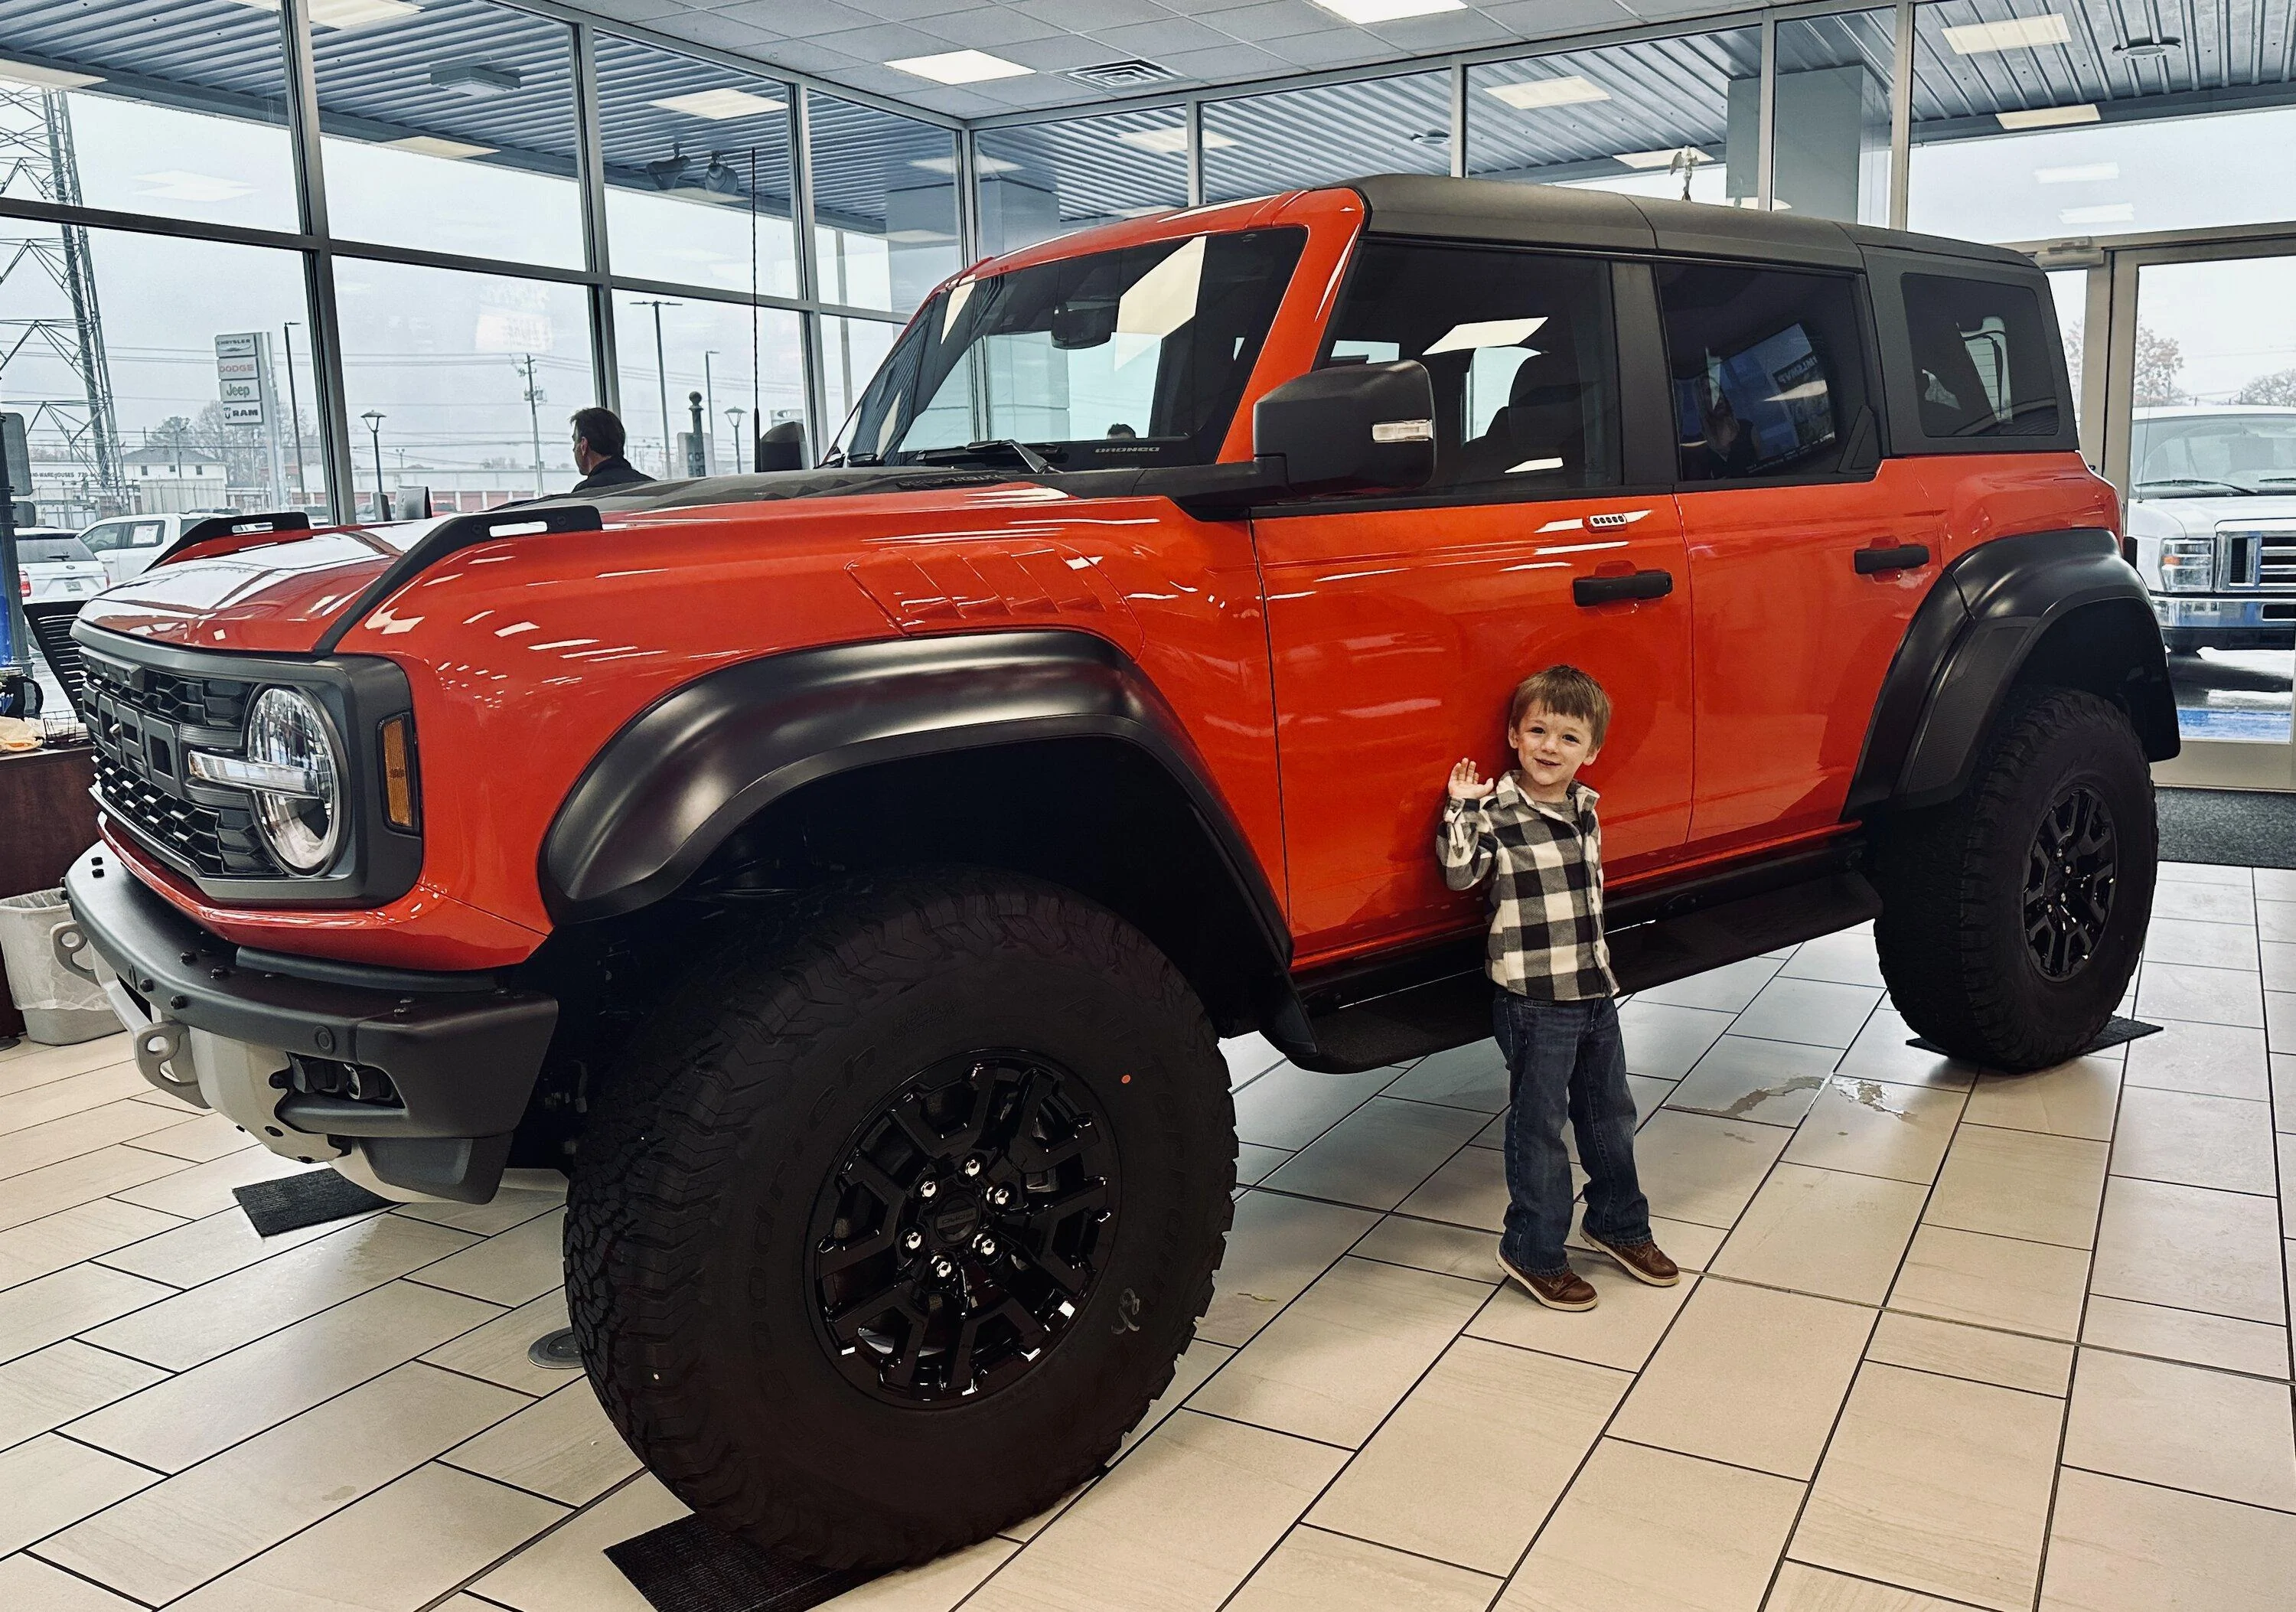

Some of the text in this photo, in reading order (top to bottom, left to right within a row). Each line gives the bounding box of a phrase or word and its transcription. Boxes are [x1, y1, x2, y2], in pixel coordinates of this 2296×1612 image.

[219, 364, 255, 373] DODGE
[227, 383, 250, 398] Jeep
[233, 409, 259, 417] RAM
